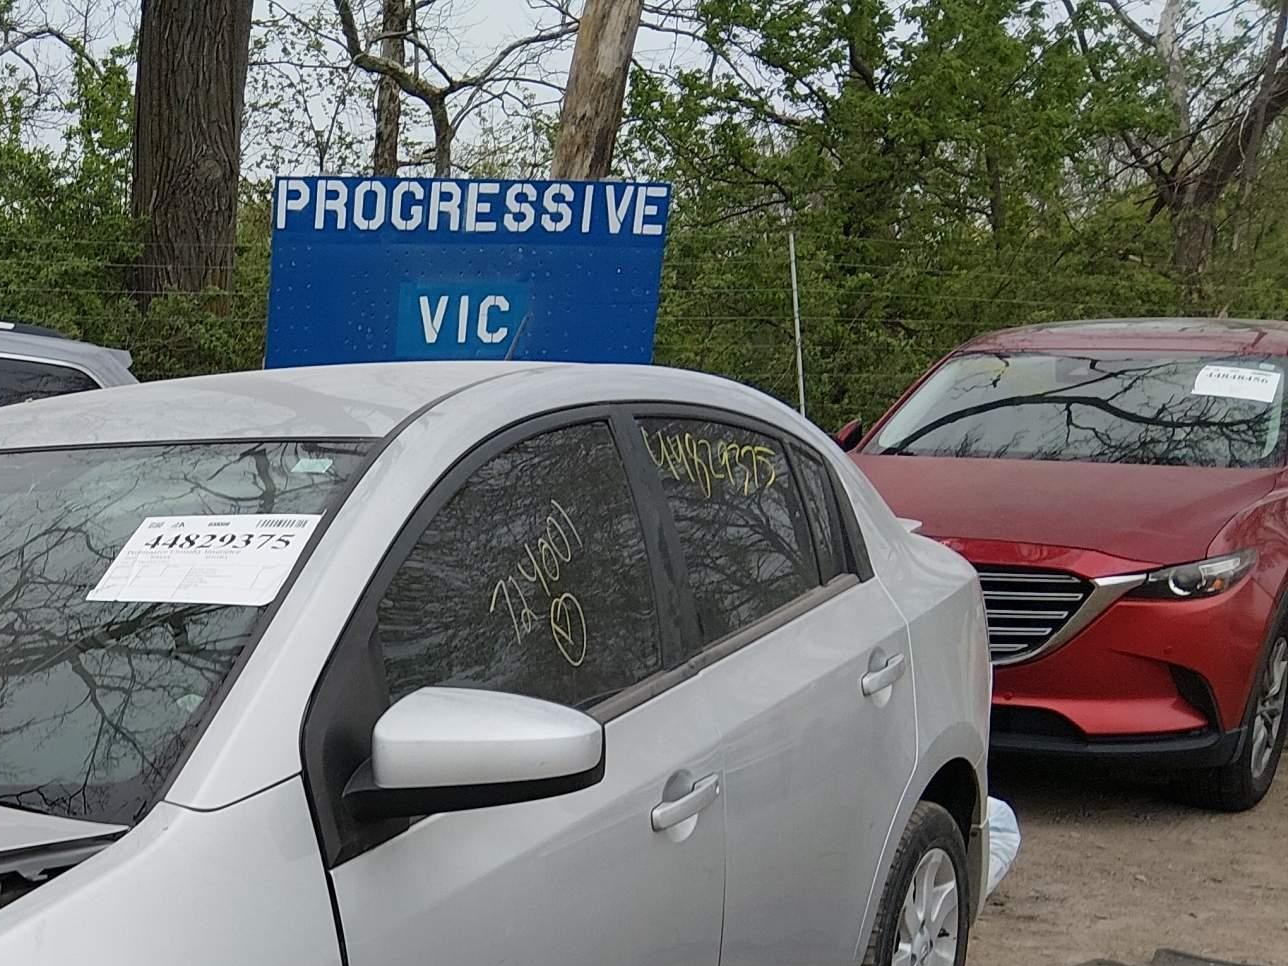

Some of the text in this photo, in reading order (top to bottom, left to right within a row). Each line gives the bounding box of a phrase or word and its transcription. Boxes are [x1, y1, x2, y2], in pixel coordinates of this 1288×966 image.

[276, 179, 668, 236] PROGRESSIVE
[419, 294, 511, 345] VIC
[640, 426, 777, 499] 44829375
[144, 533, 296, 550] 44829375
